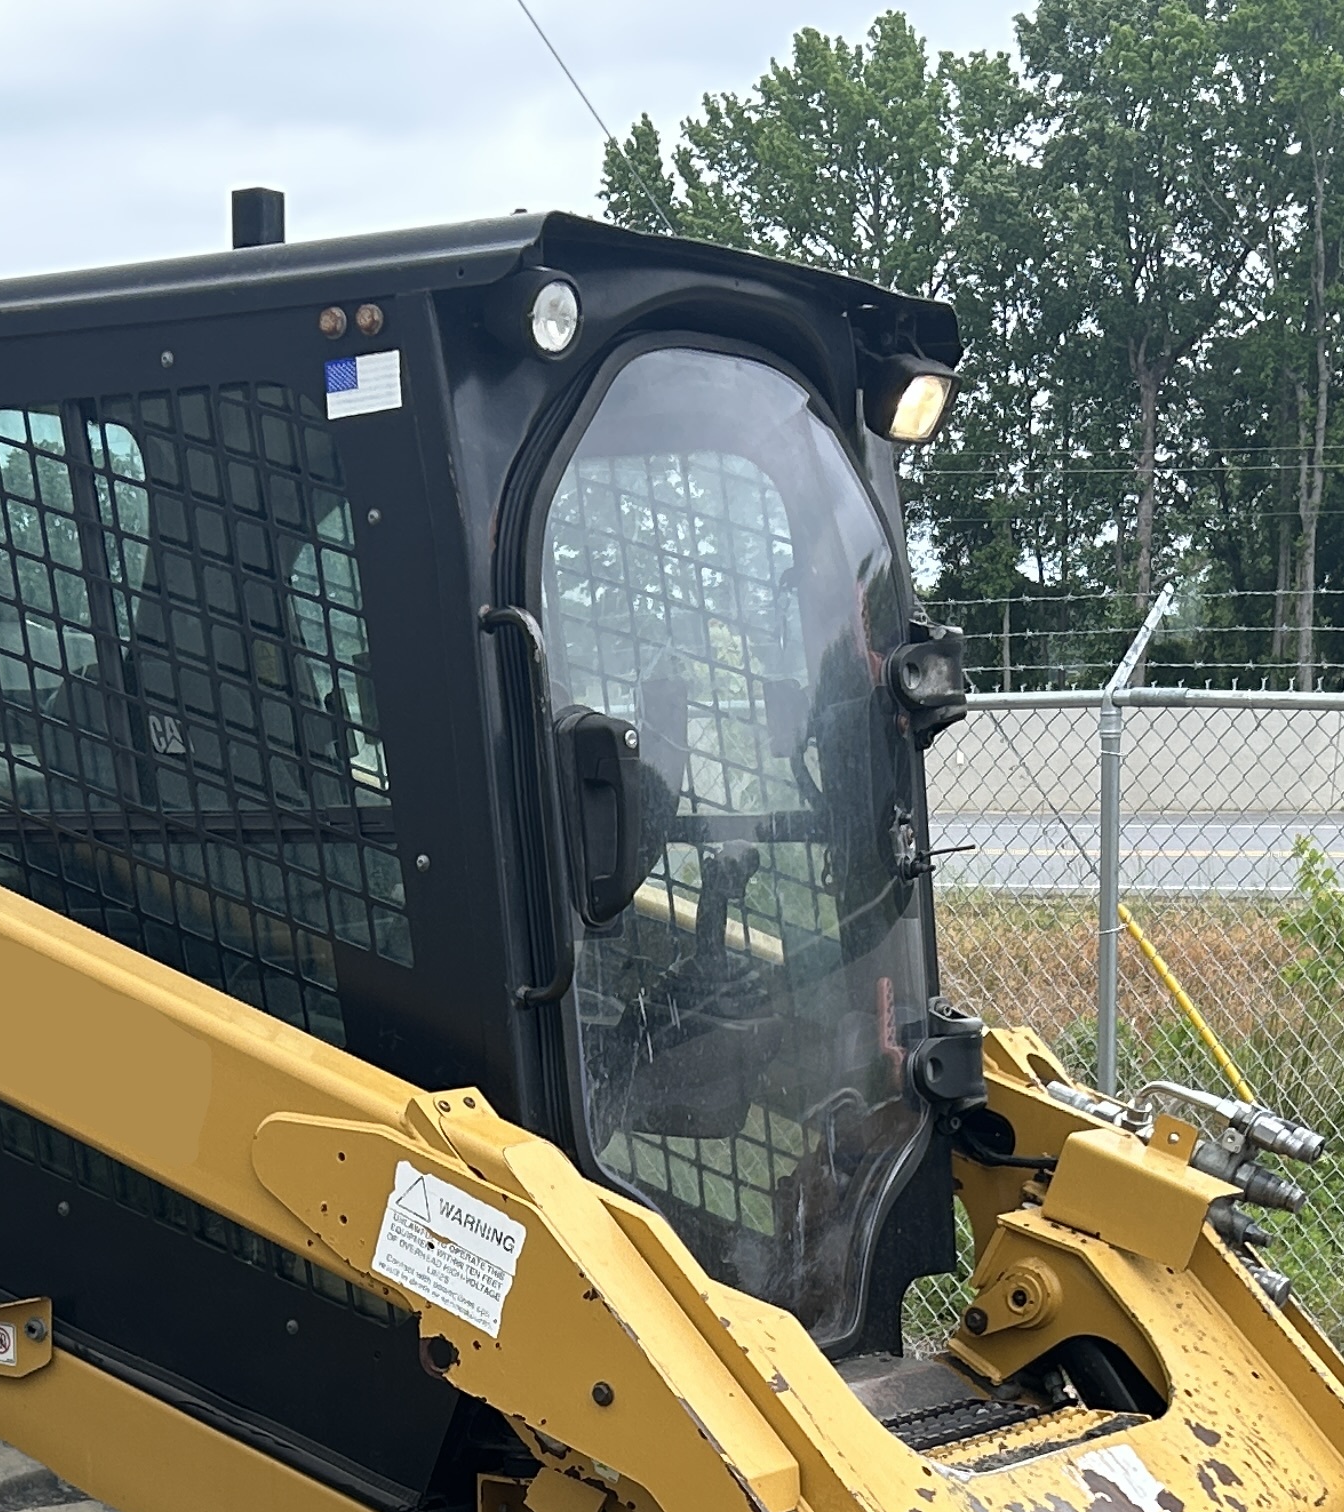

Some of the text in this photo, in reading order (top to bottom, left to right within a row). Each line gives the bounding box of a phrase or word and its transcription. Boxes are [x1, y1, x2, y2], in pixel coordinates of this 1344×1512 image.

[148, 714, 195, 754] CA
[390, 1223, 434, 1252] EQUIPME
[393, 1213, 435, 1242] UNLAWFU
[438, 1197, 516, 1255] WARNING
